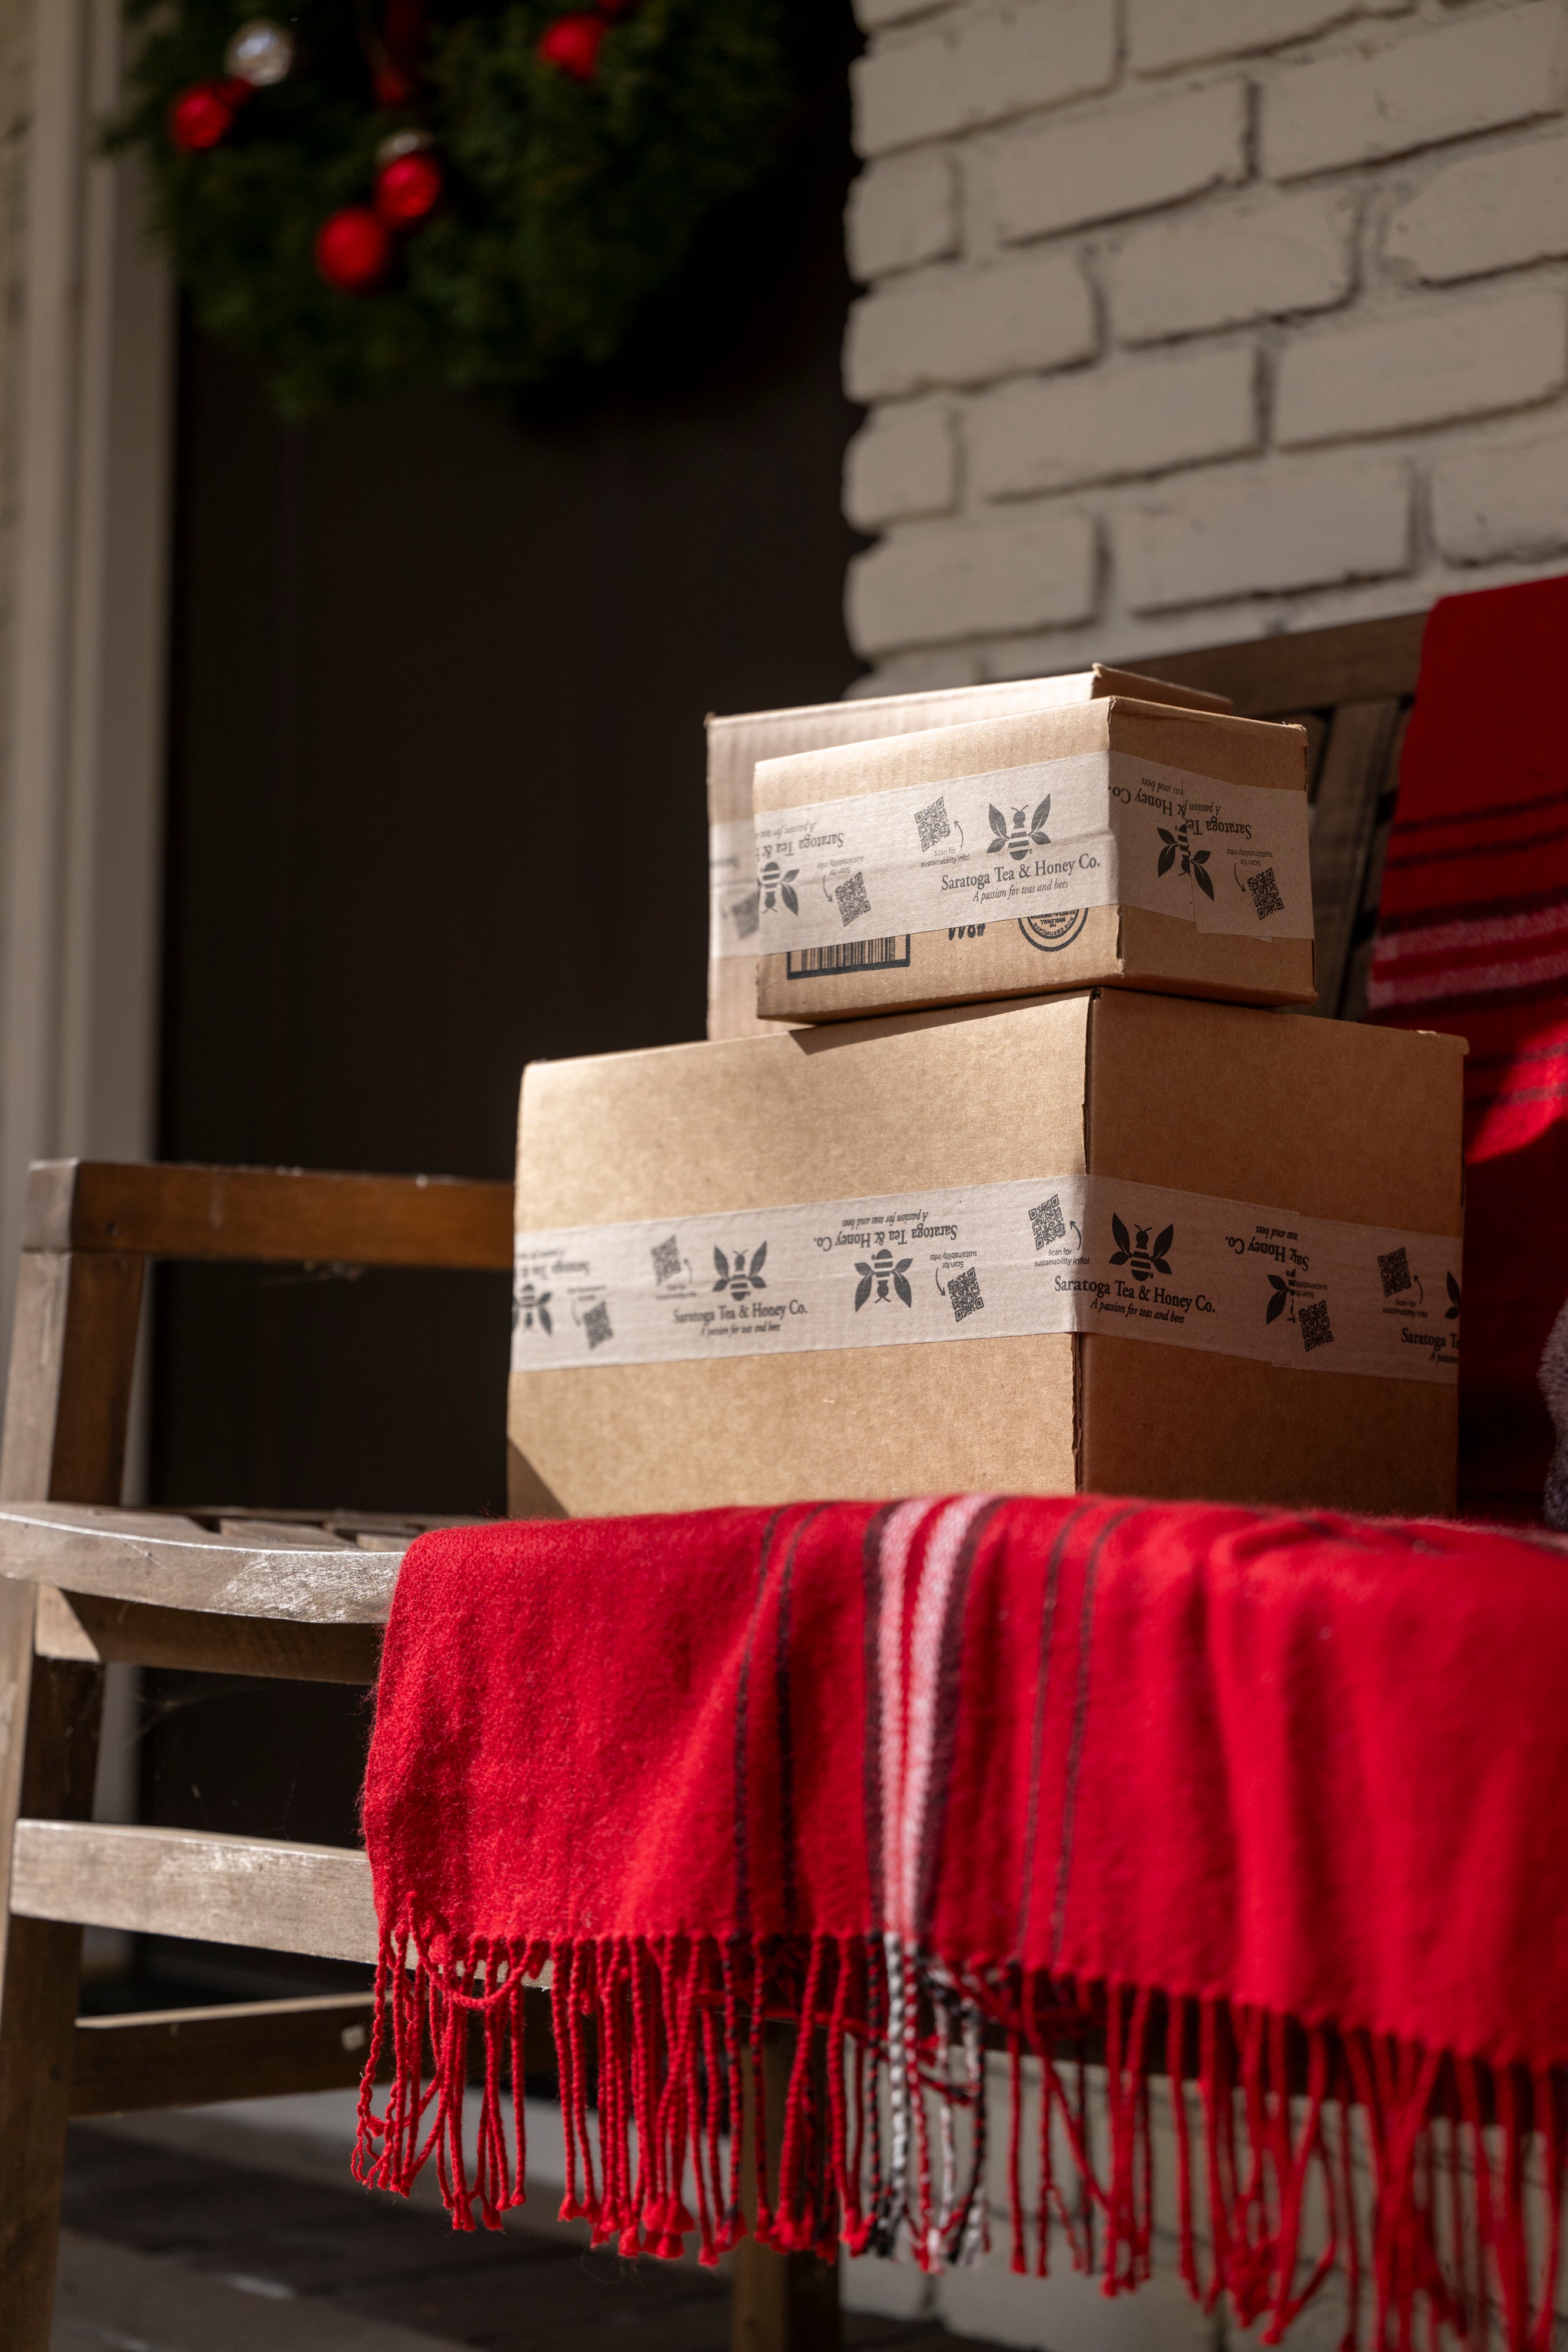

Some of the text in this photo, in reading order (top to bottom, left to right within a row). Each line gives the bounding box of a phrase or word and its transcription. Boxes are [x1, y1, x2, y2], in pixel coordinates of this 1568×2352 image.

[1141, 778, 1155, 791] bees
[1158, 783, 1171, 793] and
[1108, 787, 1131, 804] Co.
[1134, 789, 1172, 816] Honey
[1189, 802, 1213, 814] passion
[1215, 806, 1221, 816] A
[1205, 817, 1251, 840] Saratoga
[799, 833, 844, 849] Saratoga
[762, 845, 772, 858] &
[777, 842, 794, 856] Tea
[1239, 848, 1272, 857] sustainability
[921, 854, 970, 867] sustainability info!
[941, 853, 1101, 890] Saratoga Tea & Honey Co.
[972, 879, 1068, 904] A passion for teas and bees
[1034, 923, 1064, 936] CERTIFICATE
[885, 1212, 897, 1227] for
[897, 1210, 922, 1222] passion
[922, 1211, 929, 1222] A
[842, 1220, 854, 1230] bees
[856, 1217, 870, 1230] and
[814, 1223, 957, 1251] Saratoga Tea & Honey Co.
[1256, 1226, 1269, 1238] bees
[1271, 1230, 1285, 1240] and
[1225, 1236, 1245, 1254] Co.
[1248, 1237, 1286, 1262] Honey
[942, 1251, 977, 1259] sustainability
[1034, 1256, 1089, 1267] sustainability info!
[1055, 1275, 1215, 1313] Saratoga Tea & Honey Co.
[673, 1299, 807, 1327] Saratoga Tea & Honey Co.
[1090, 1298, 1185, 1324] A passion for teas and bees
[1402, 1328, 1446, 1351] Saratoga
